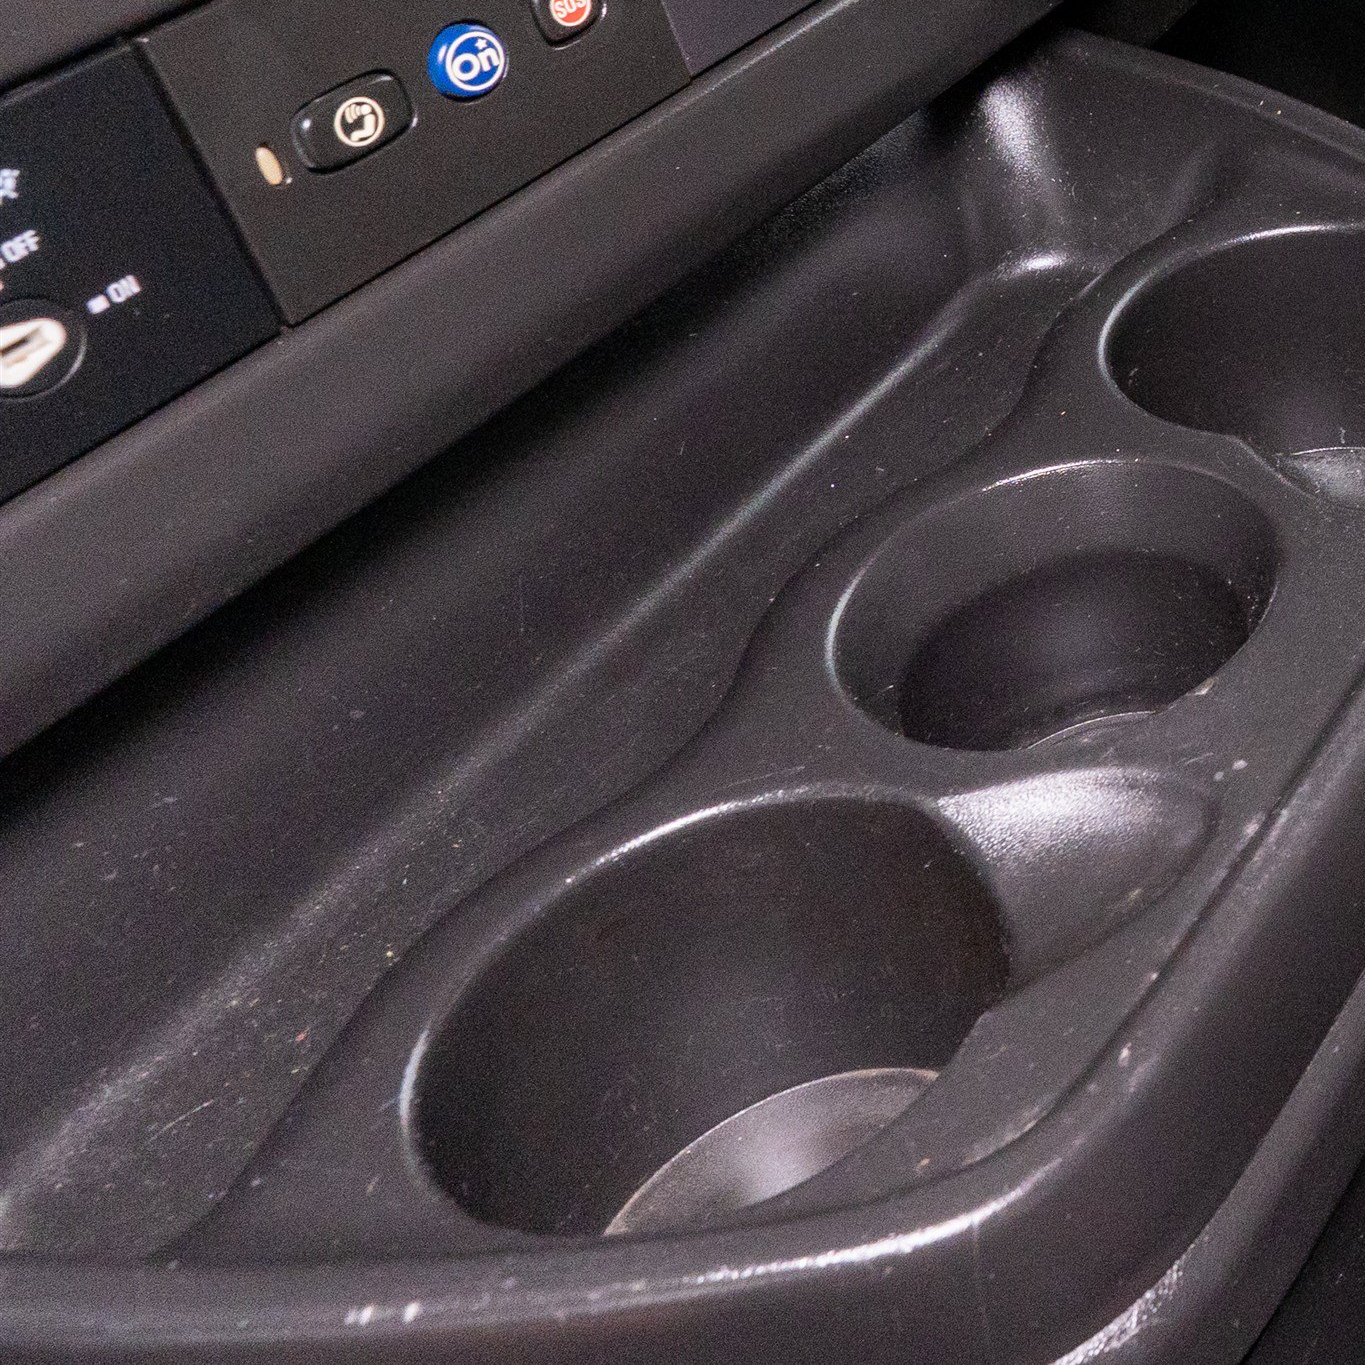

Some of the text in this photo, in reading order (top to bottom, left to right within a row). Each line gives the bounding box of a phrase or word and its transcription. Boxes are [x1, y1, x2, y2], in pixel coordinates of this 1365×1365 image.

[451, 46, 500, 82] On
[0, 229, 40, 263] OFF
[105, 274, 142, 303] ON
